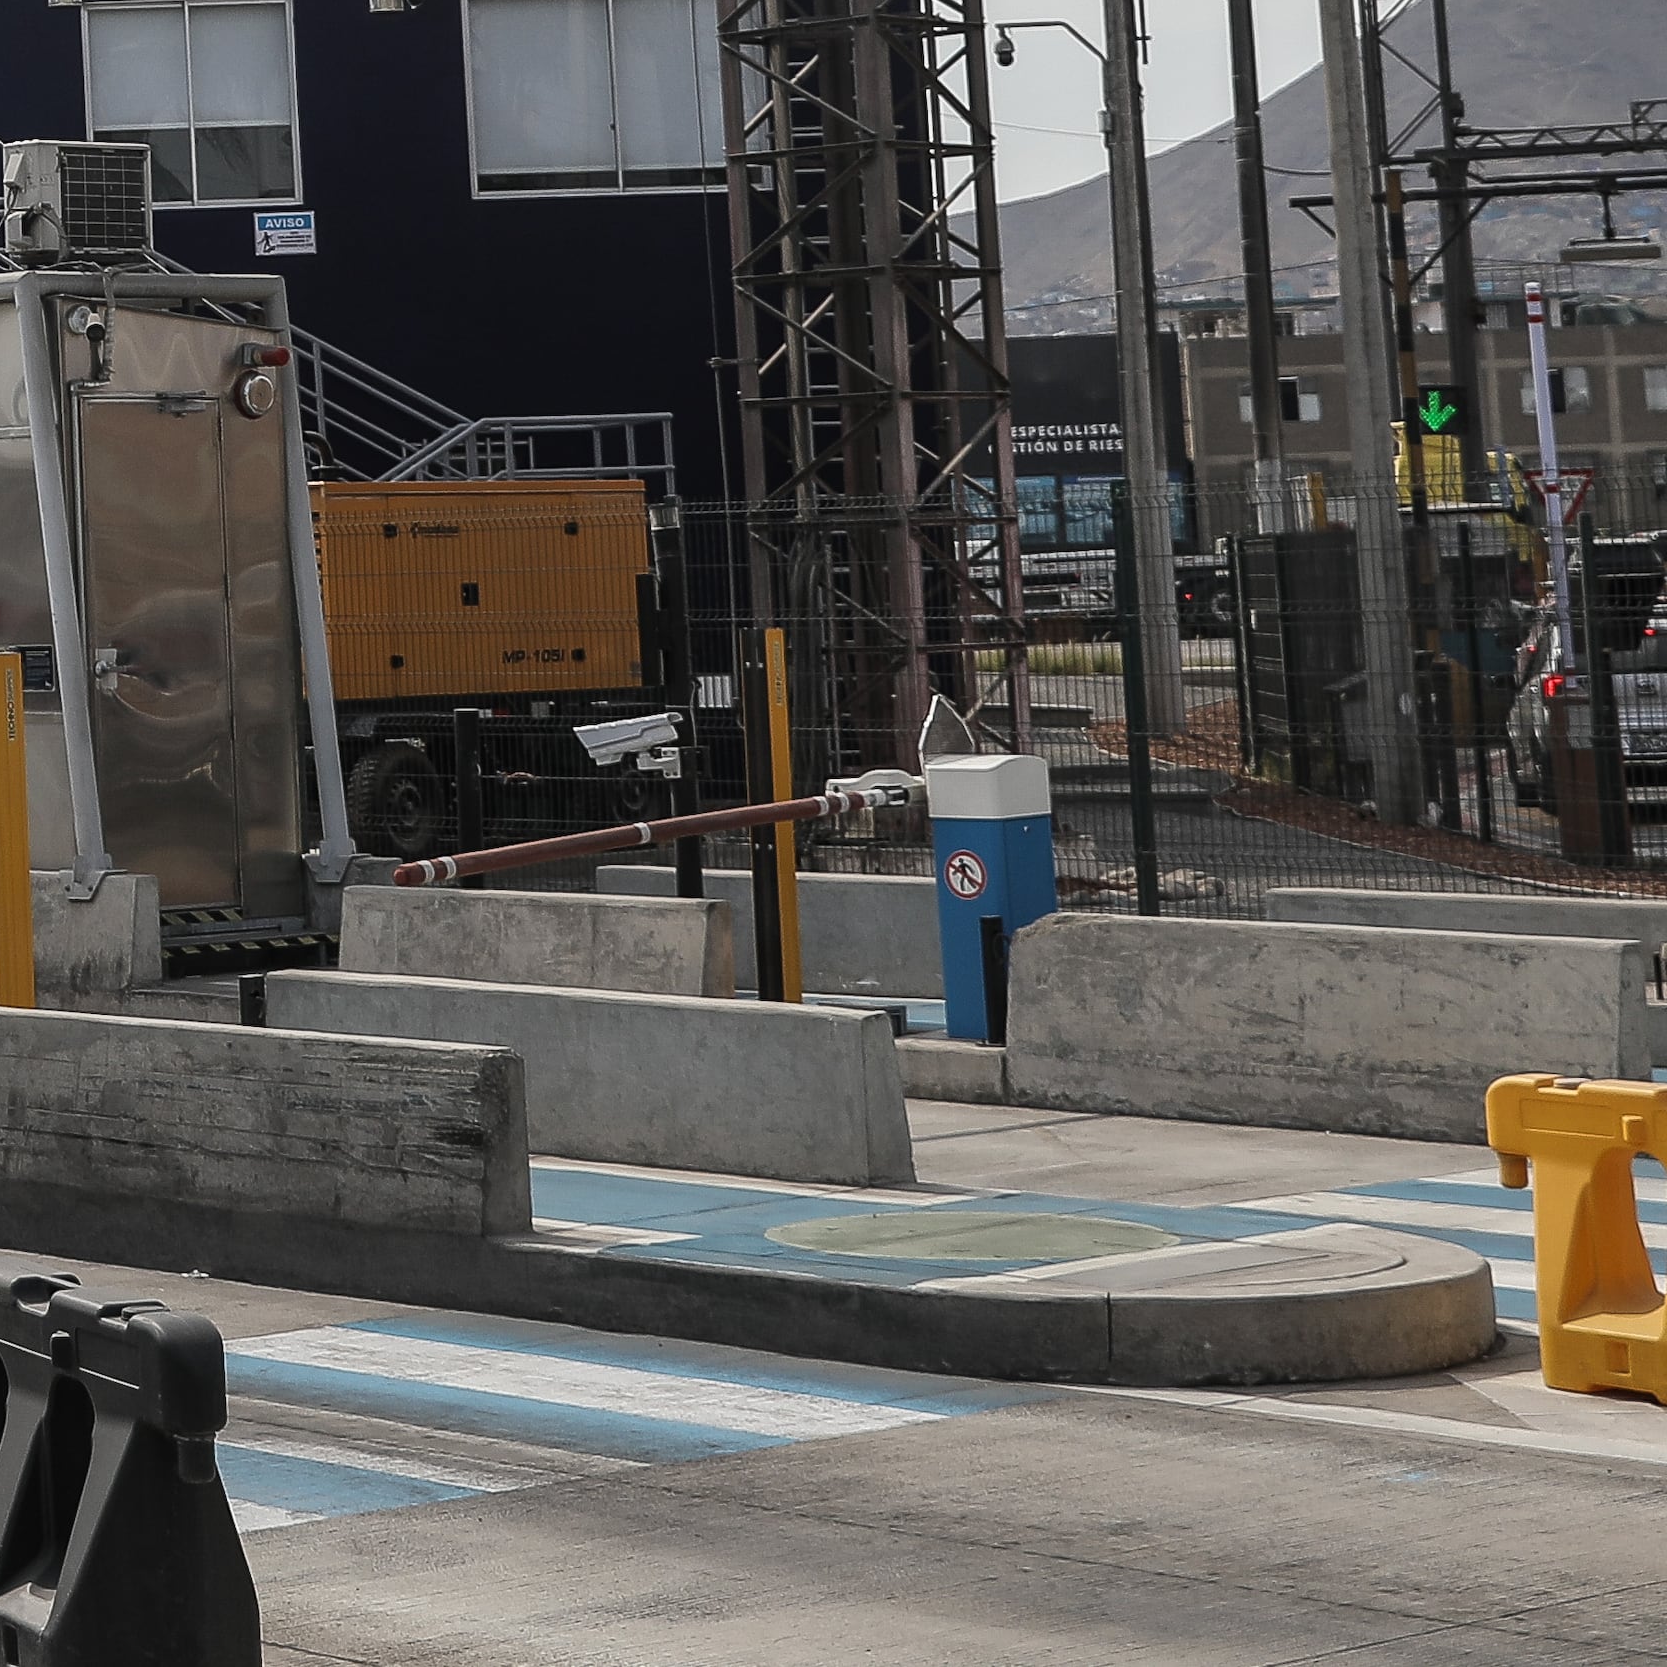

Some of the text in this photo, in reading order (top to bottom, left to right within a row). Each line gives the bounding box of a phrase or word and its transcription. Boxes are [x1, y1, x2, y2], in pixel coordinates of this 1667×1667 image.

[265, 217, 305, 229] AVISO
[1010, 423, 1123, 438] ESPECIALISTA
[1064, 440, 1084, 452] DE
[1089, 438, 1124, 452] RIES
